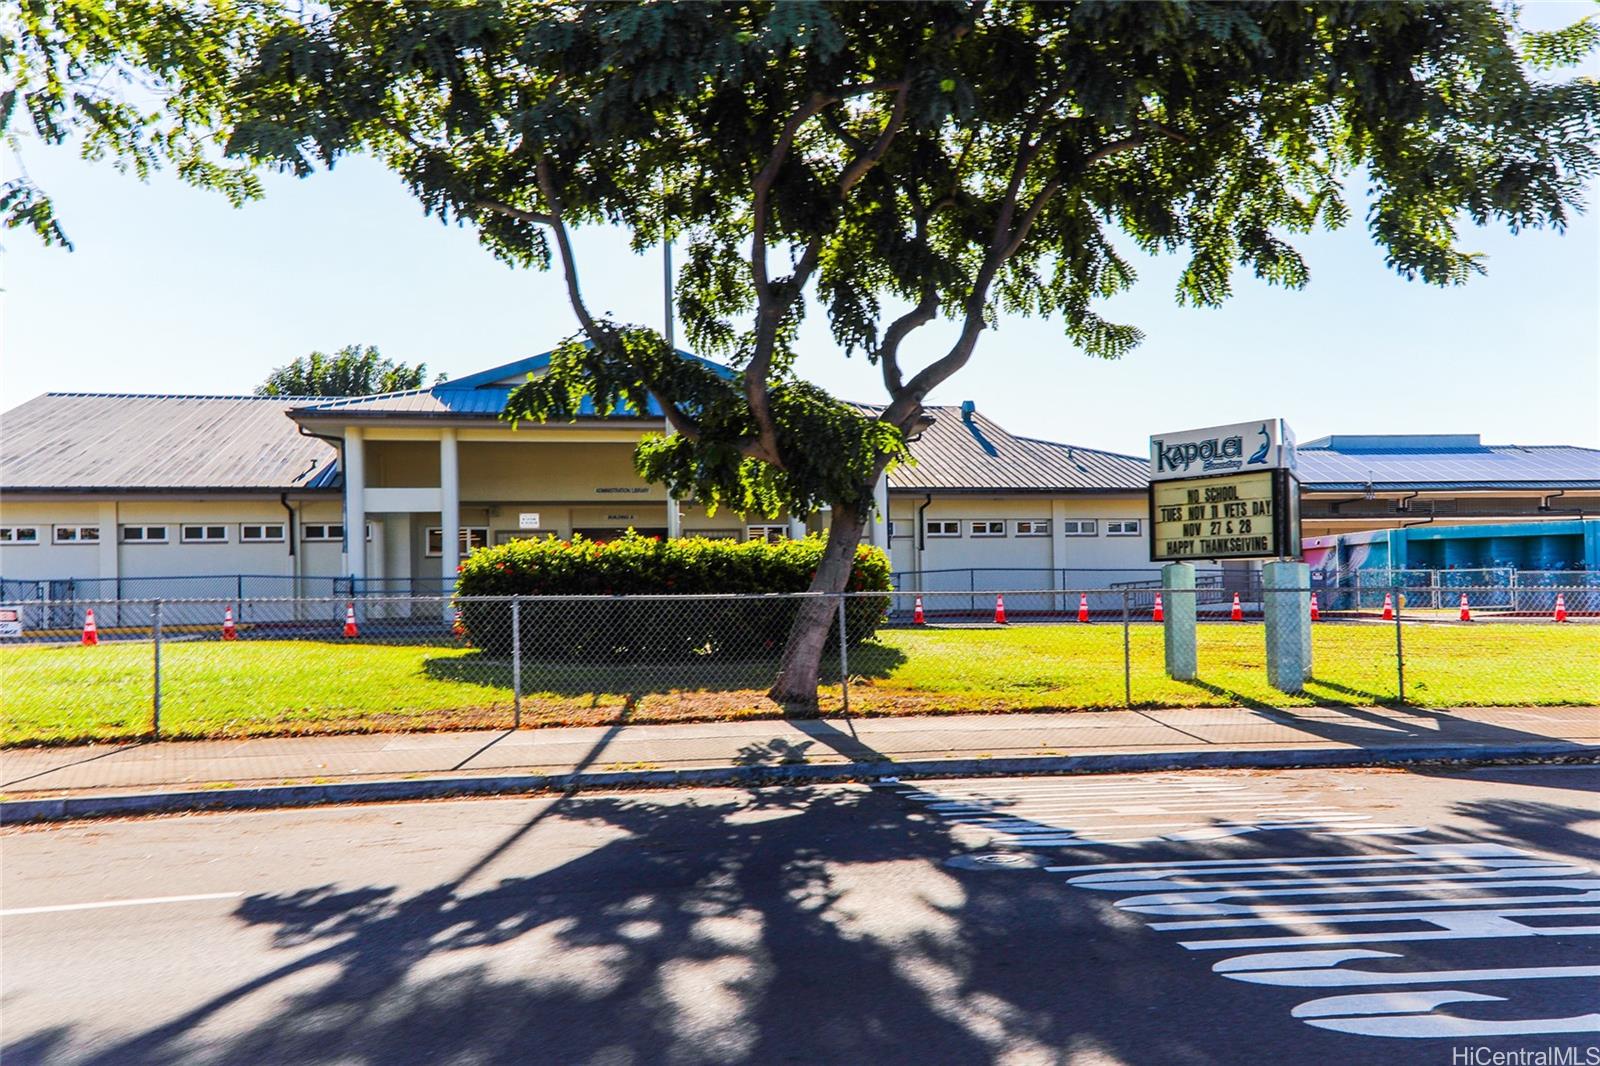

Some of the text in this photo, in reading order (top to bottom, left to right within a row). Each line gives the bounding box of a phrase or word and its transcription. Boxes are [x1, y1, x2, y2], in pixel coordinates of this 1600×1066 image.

[1187, 486, 1238, 504] NO SCHOOL
[1161, 507, 1182, 522] TUES
[1188, 505, 1205, 520] NOV
[1224, 503, 1247, 517] VETS
[1253, 500, 1272, 516] DAY
[1183, 519, 1251, 537] NOV 27 & 28
[1167, 536, 1268, 555] HAPPY THANKSGIVING
